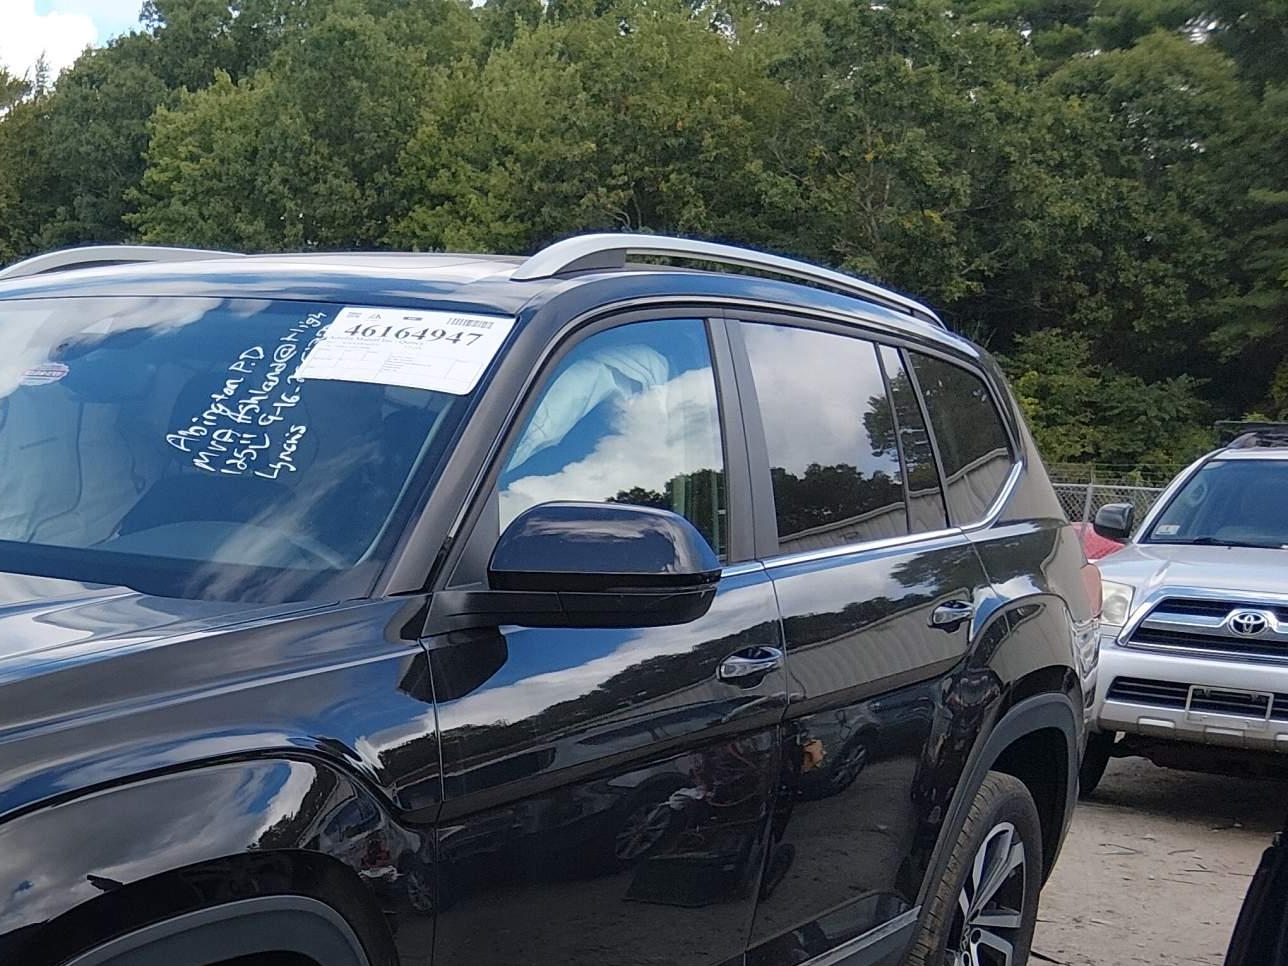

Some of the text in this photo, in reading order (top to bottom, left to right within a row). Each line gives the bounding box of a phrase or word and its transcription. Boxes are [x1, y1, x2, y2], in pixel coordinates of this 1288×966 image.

[344, 324, 483, 346] 46164947
[166, 377, 244, 451] Abington
[193, 429, 241, 472] MVA
